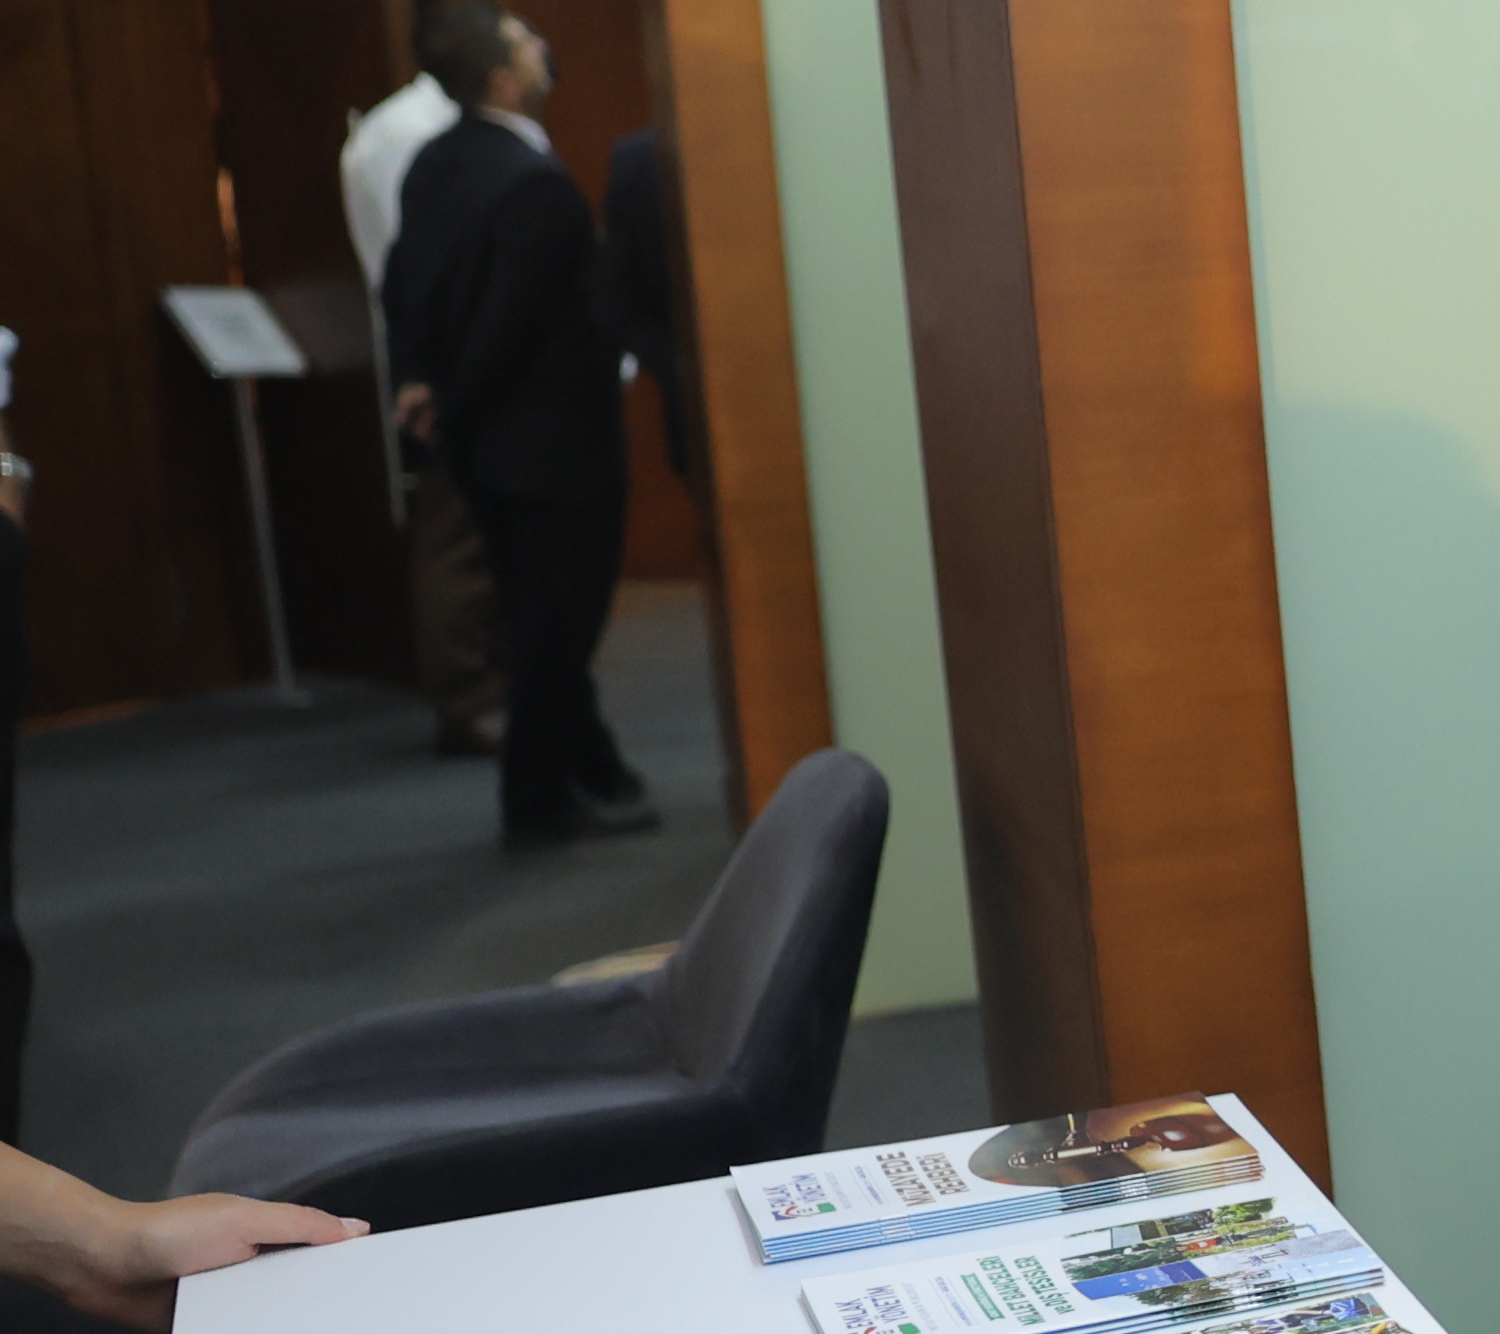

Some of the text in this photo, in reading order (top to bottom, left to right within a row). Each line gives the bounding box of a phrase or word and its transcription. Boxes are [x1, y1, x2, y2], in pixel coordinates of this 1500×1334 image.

[876, 1152, 936, 1207] MÜZAYEDE
[916, 1152, 970, 1195] REHBERİ
[976, 1255, 1026, 1301] BAHÇELERİ
[1014, 1255, 1075, 1315] ve DIŞ TESİSLER
[835, 1298, 874, 1329] EMLAK
[863, 1284, 909, 1324] YÖNETİM
[1006, 1300, 1046, 1326] MİLLET
